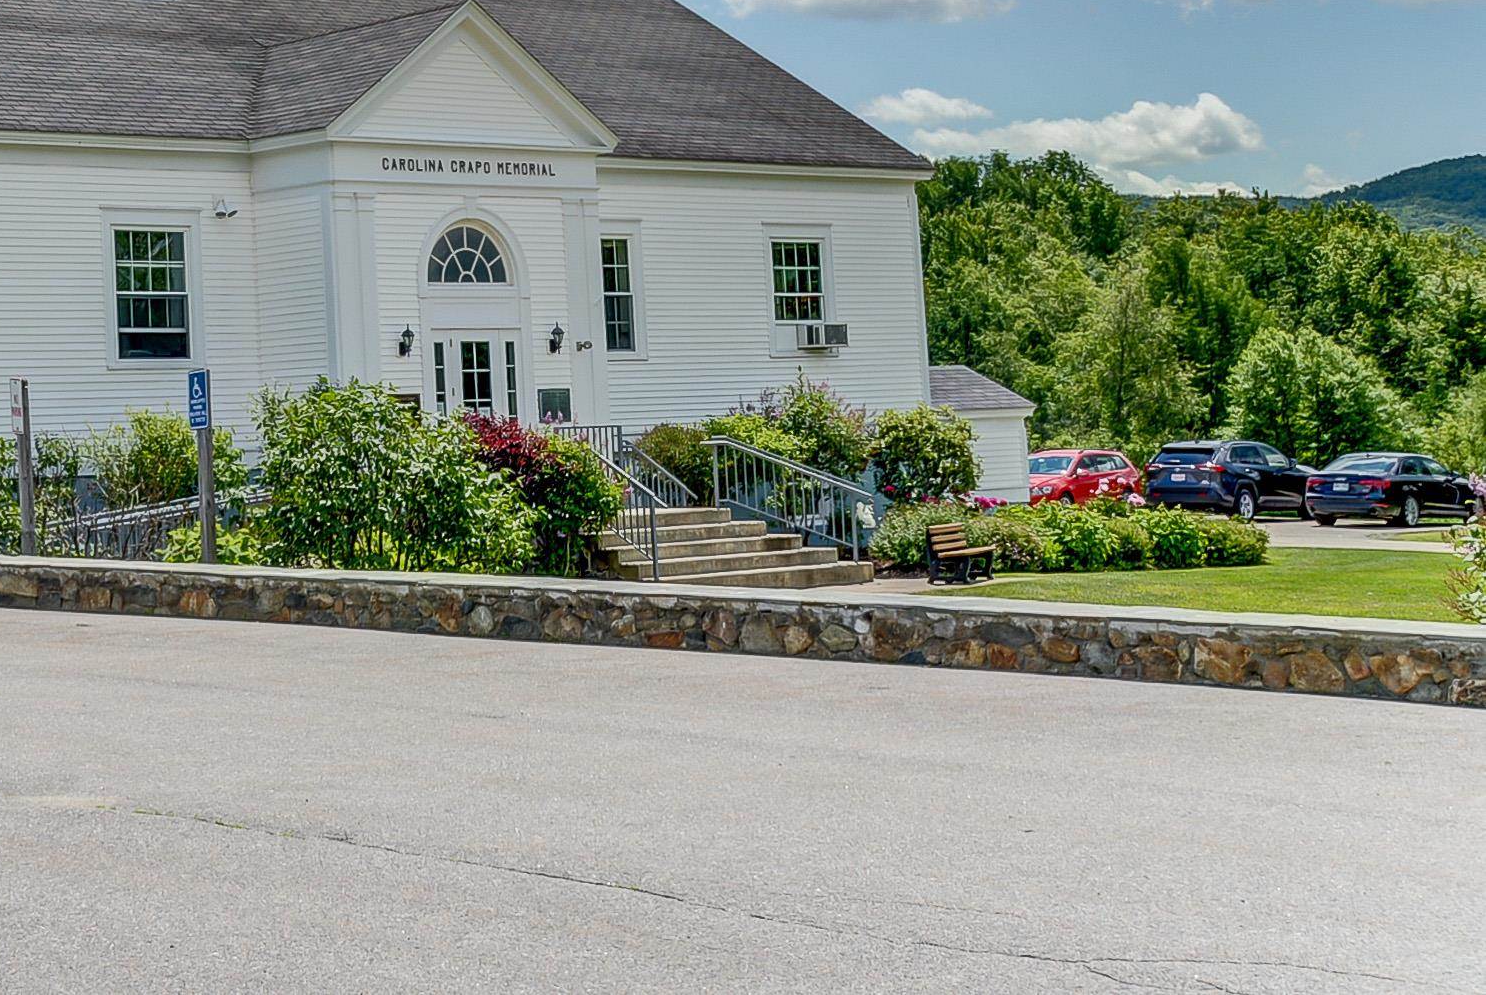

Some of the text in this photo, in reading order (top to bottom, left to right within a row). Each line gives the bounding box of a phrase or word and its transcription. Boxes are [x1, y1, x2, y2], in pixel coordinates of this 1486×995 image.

[381, 157, 556, 177] CAROLINA CRAPO MEMORIAL
